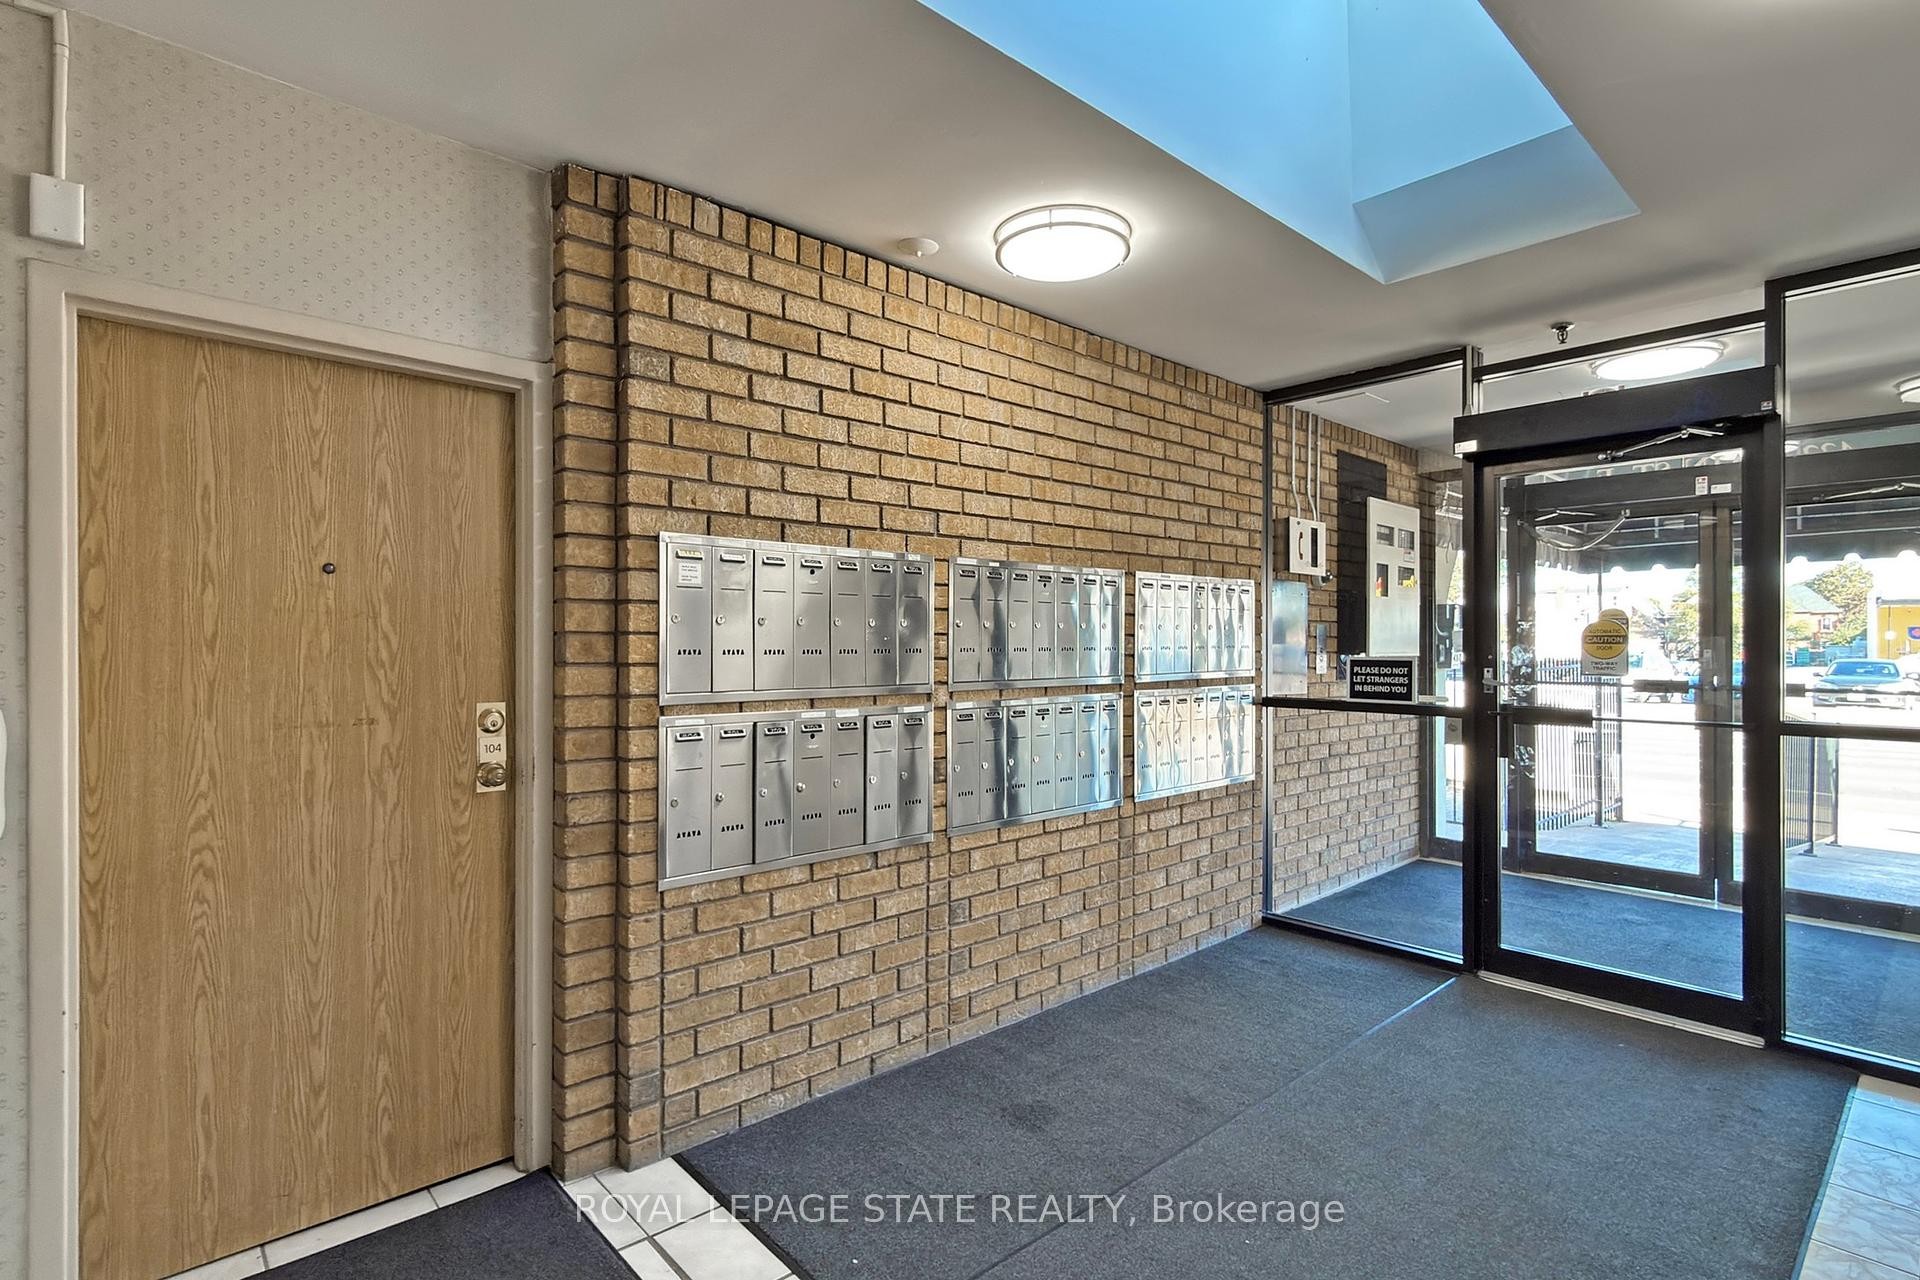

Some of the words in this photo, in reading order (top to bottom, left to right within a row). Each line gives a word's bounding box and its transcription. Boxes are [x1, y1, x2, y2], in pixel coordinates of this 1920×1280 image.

[1354, 666, 1379, 674] PLEASE
[1366, 676, 1408, 684] STRANGERS
[1354, 684, 1362, 692] IN
[1363, 684, 1390, 692] BEHIND
[484, 744, 502, 753] 104
